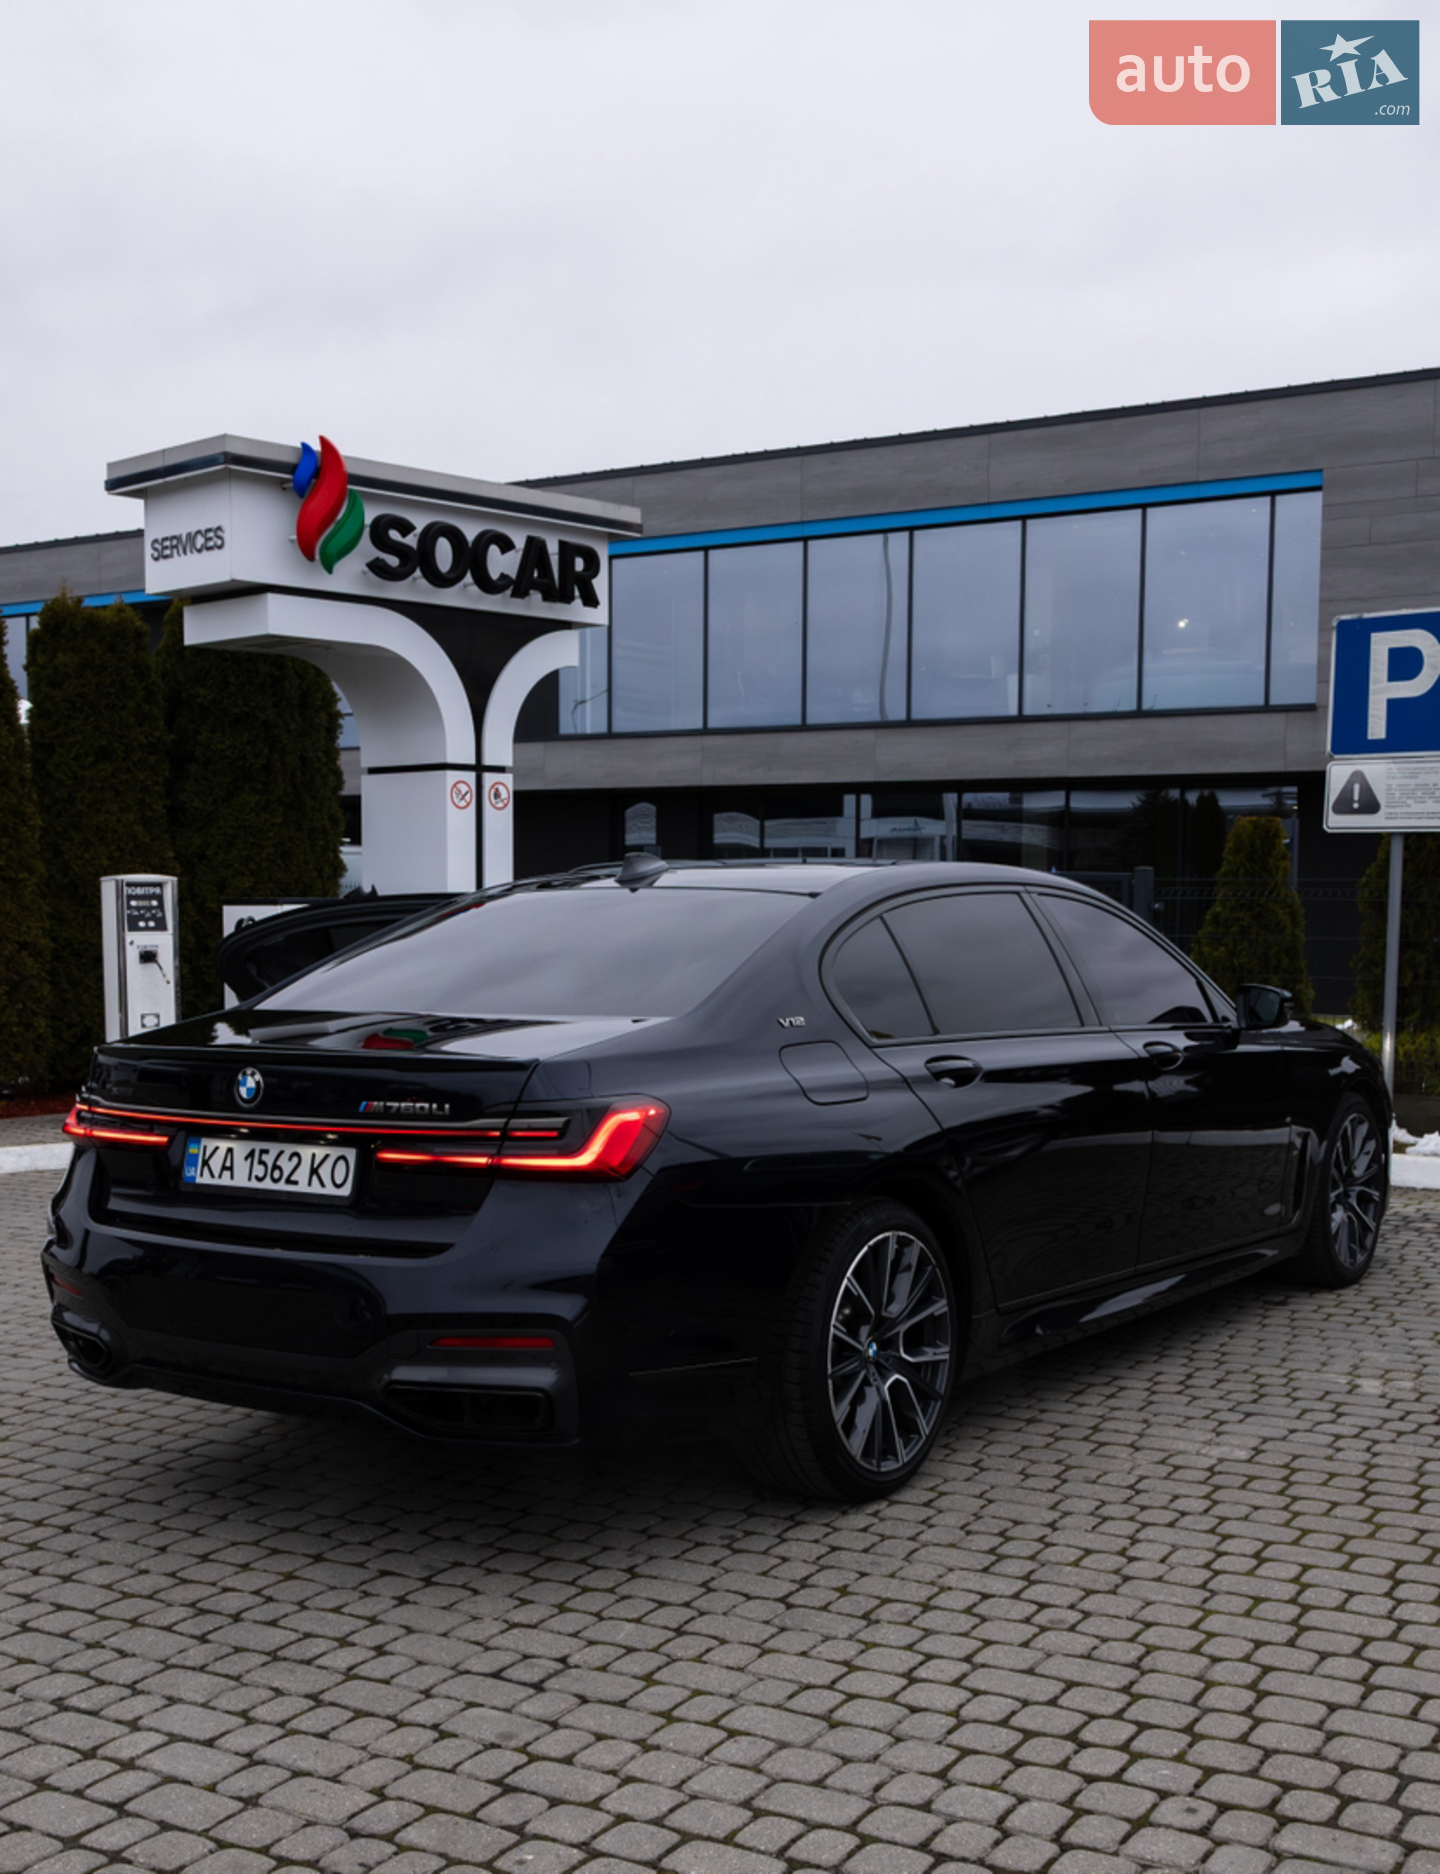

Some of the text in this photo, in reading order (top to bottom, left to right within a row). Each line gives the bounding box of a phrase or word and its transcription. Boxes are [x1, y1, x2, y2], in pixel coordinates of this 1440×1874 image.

[150, 525, 225, 562] SERVICES
[366, 513, 601, 609] SOCAR
[1367, 628, 1440, 740] P
[777, 1016, 806, 1029] V12
[199, 1145, 235, 1181] KA
[244, 1148, 303, 1186] 1562
